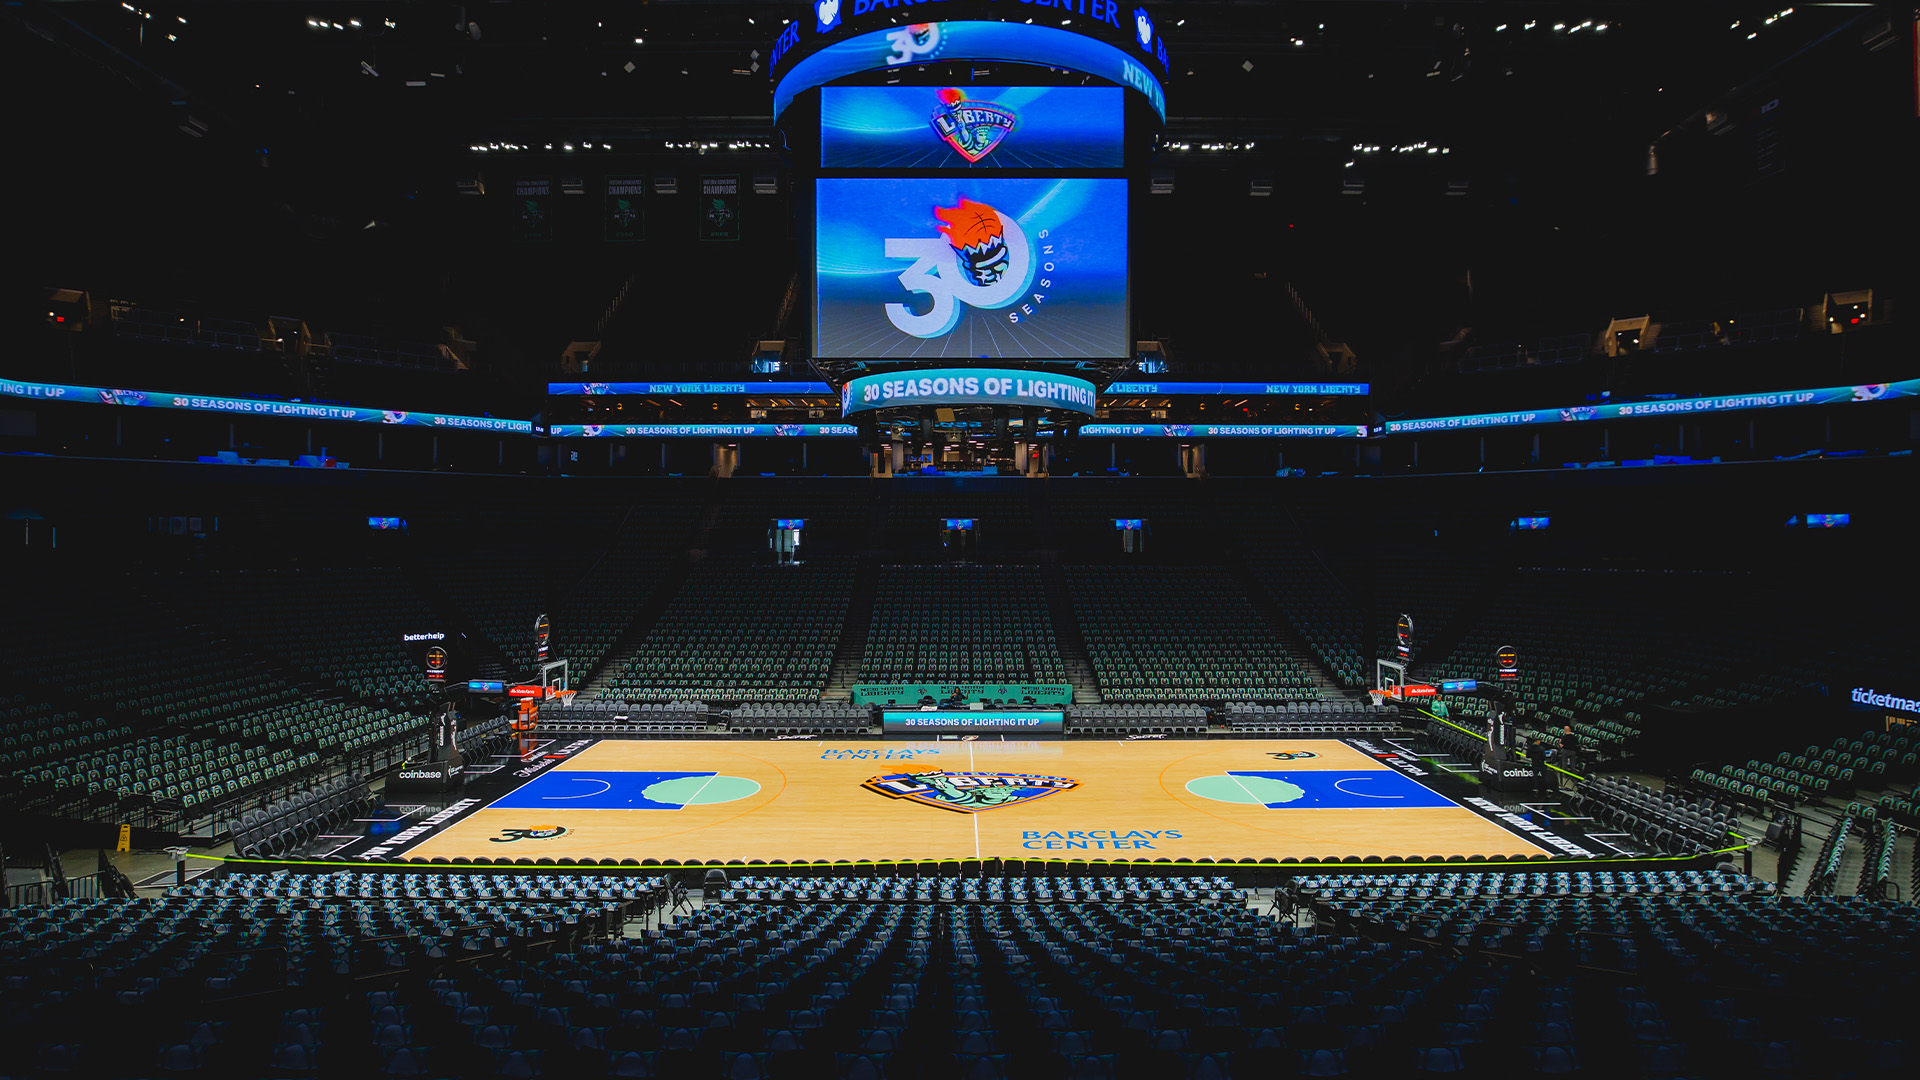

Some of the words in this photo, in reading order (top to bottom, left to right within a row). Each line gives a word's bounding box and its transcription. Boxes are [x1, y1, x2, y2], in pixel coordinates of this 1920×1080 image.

[1123, 59, 1153, 98] NEW
[608, 185, 642, 195] CHAMPIONS
[703, 185, 737, 195] CHAMPIONS
[885, 208, 1036, 338] 30
[1009, 228, 1055, 324] SEASONS
[27, 386, 42, 396] IT
[45, 388, 66, 397] UP
[649, 384, 673, 393] NEW
[676, 384, 701, 393] YORK
[703, 384, 745, 393] LIBERTY
[864, 382, 879, 401] 30
[882, 377, 979, 398] SEASONS
[984, 377, 1013, 396] OF
[1017, 379, 1087, 405] LIGHTING
[1116, 384, 1158, 393] LIBERTY
[1266, 385, 1289, 393] NEW
[1292, 385, 1318, 393] YORK
[1320, 385, 1361, 394] LIBERTY
[173, 397, 188, 407] 30
[191, 399, 251, 412] SEASONS
[254, 403, 271, 412] OF
[272, 404, 327, 417] LIGHTING
[328, 409, 338, 417] IT
[341, 409, 356, 419] UP
[1619, 406, 1633, 415] 30
[1635, 402, 1692, 414] SEASONS
[1695, 400, 1712, 409] OF
[1715, 395, 1777, 409] LIGHTING
[1779, 393, 1793, 403] IT
[1796, 392, 1815, 402] UP
[434, 417, 446, 425] 30
[448, 418, 492, 428] SEASONS
[494, 421, 506, 429] OF
[1390, 423, 1401, 431] 30
[1402, 420, 1446, 431] SEASONS
[1448, 419, 1460, 427] OF
[1462, 416, 1508, 427] LIGHTING
[1510, 414, 1520, 423] IT
[1522, 413, 1536, 422] UP
[551, 427, 563, 435] UP
[625, 427, 636, 435] 30
[637, 427, 679, 435] SEASONS
[680, 427, 690, 435] OF
[692, 427, 732, 435] LIGHTING
[733, 427, 742, 435] IT
[743, 427, 755, 435] UP
[819, 427, 830, 435] 30
[1208, 427, 1218, 435] 30
[1220, 427, 1261, 435] SEASONS
[1262, 427, 1273, 435] OF
[1274, 427, 1313, 435] LIGHTING
[1315, 427, 1323, 435] IT
[1325, 427, 1336, 435] UP
[404, 632, 445, 641] betterhelp
[905, 718, 915, 726] 30
[917, 718, 959, 726] SEASONS
[961, 718, 973, 726] OF
[974, 718, 1016, 726] LIGHTING
[1017, 718, 1026, 726] IT
[1027, 718, 1040, 726] UP
[399, 770, 442, 779] coinbase
[1022, 830, 1183, 840] BARCLAYS
[1022, 840, 1158, 849] CENTER
